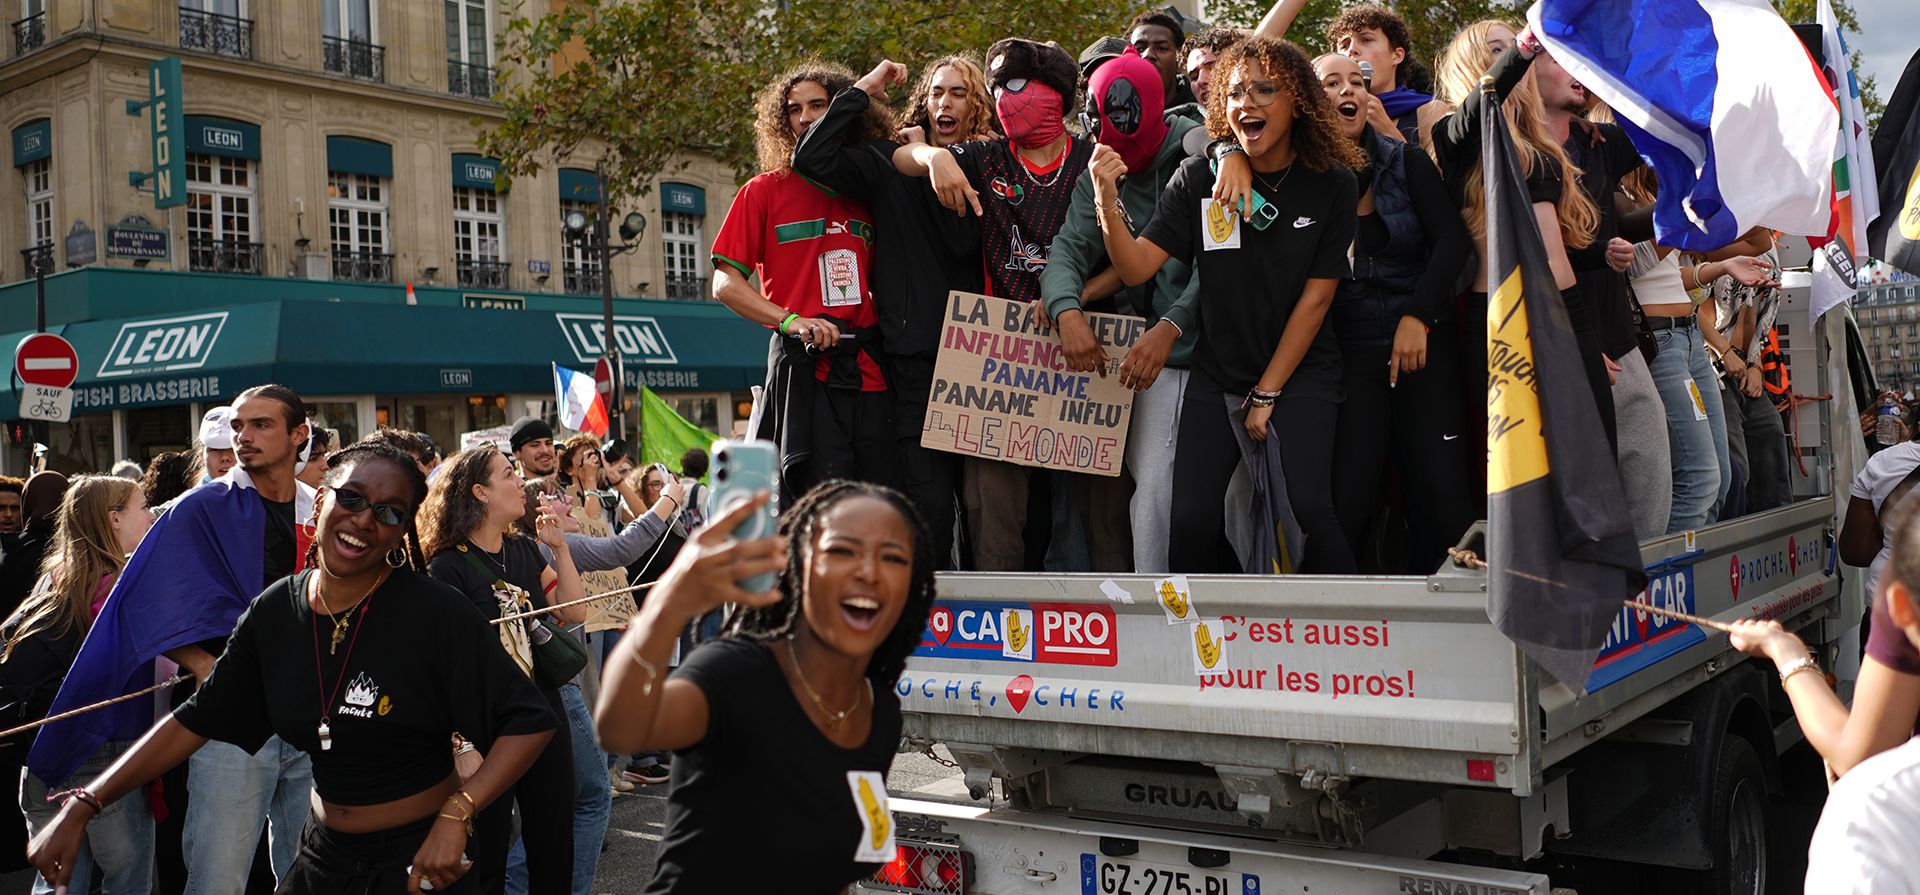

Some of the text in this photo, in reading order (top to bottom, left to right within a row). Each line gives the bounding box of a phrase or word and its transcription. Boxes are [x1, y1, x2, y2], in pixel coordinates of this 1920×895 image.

[951, 295, 989, 326] LA
[944, 326, 1079, 373] INFLUENC
[36, 387, 63, 398] SAUF
[74, 376, 220, 407] FISH BRASSERIE
[626, 371, 699, 388] RASSERIE
[931, 379, 1039, 418] PANAME
[955, 414, 1117, 470] LE MONDE
[1651, 572, 1688, 629] CAR
[957, 610, 1003, 642] CA
[1043, 610, 1109, 646] PRO
[1219, 615, 1389, 647] C'est aussi
[897, 677, 1125, 712] OCHE, CHER
[1199, 664, 1415, 700] pour les pros!
